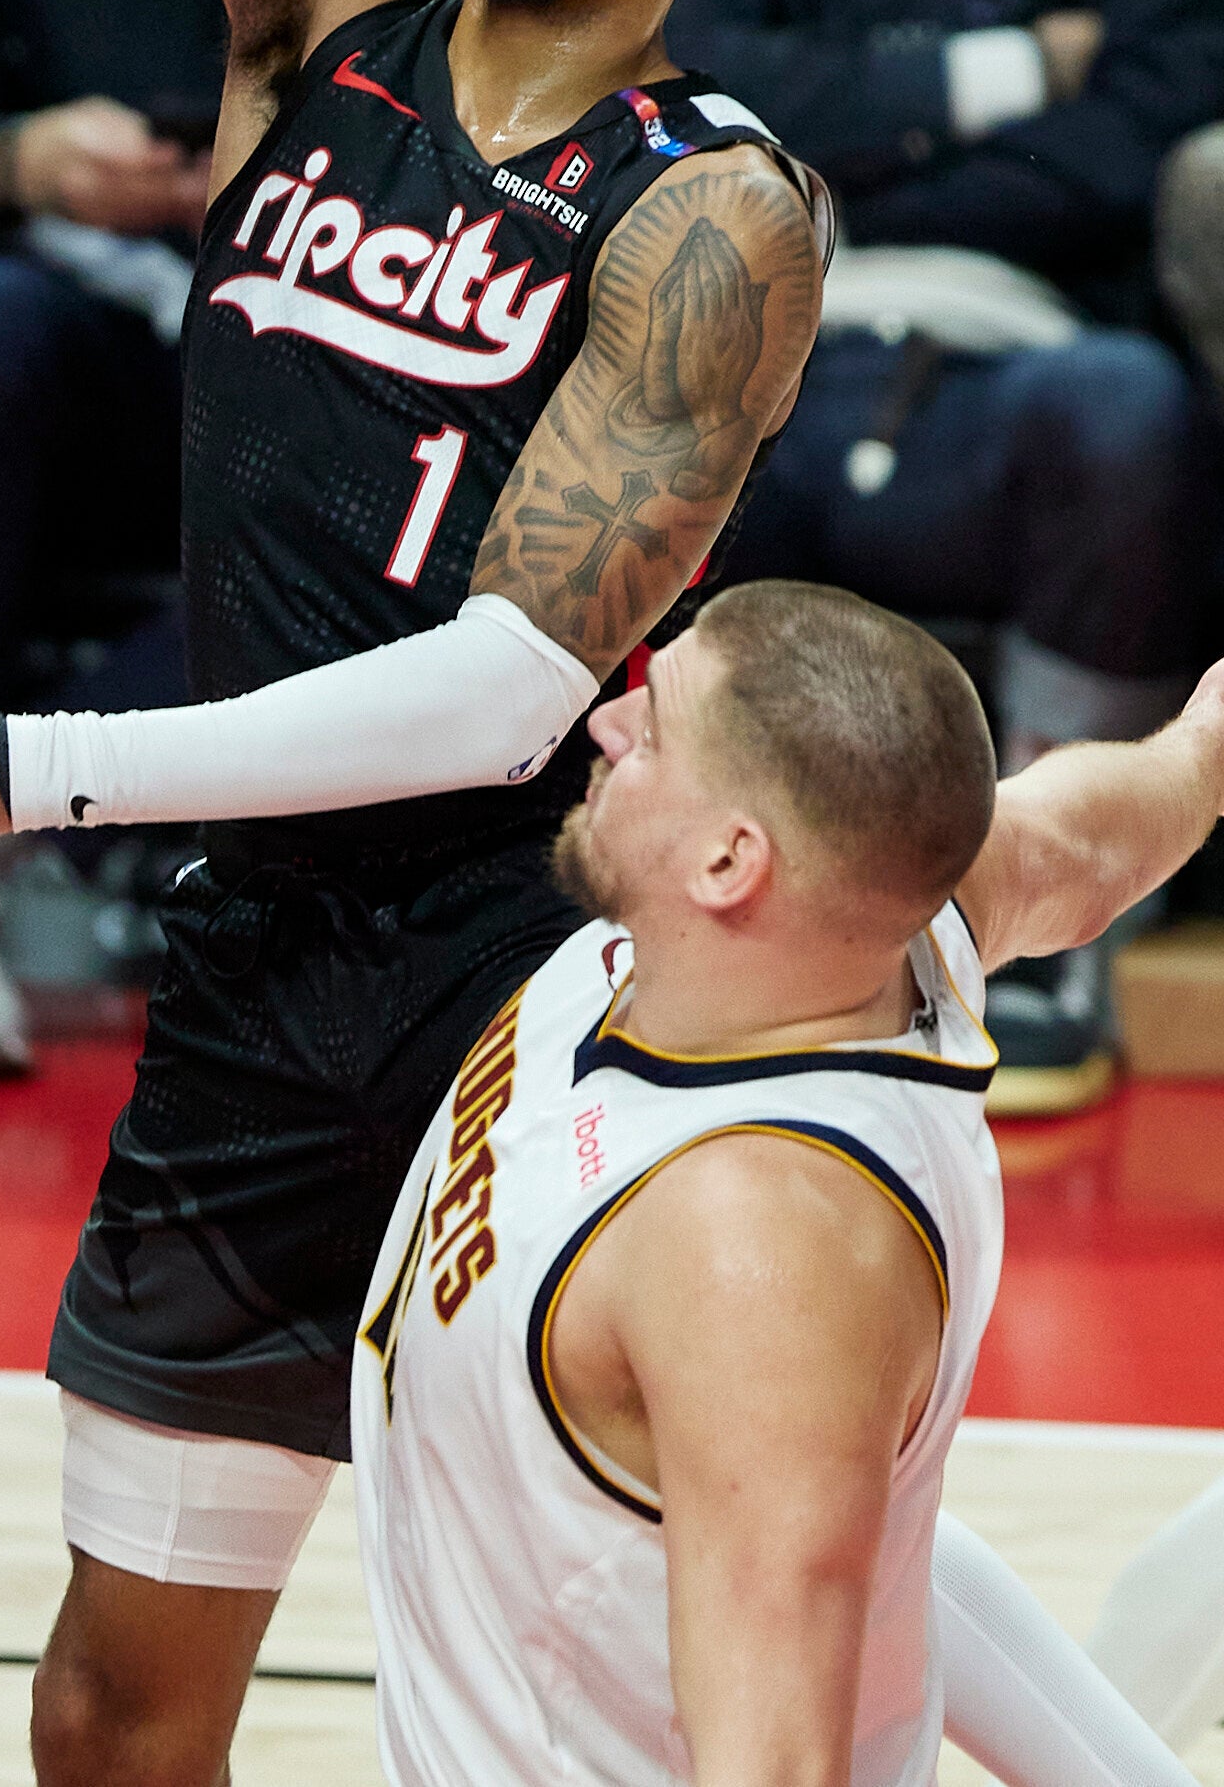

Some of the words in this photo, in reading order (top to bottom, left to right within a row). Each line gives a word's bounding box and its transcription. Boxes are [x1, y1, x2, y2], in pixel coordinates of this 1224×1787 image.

[558, 154, 587, 188] B
[644, 116, 672, 150] 32
[384, 423, 468, 587] 1
[429, 975, 530, 1327] NUGETS
